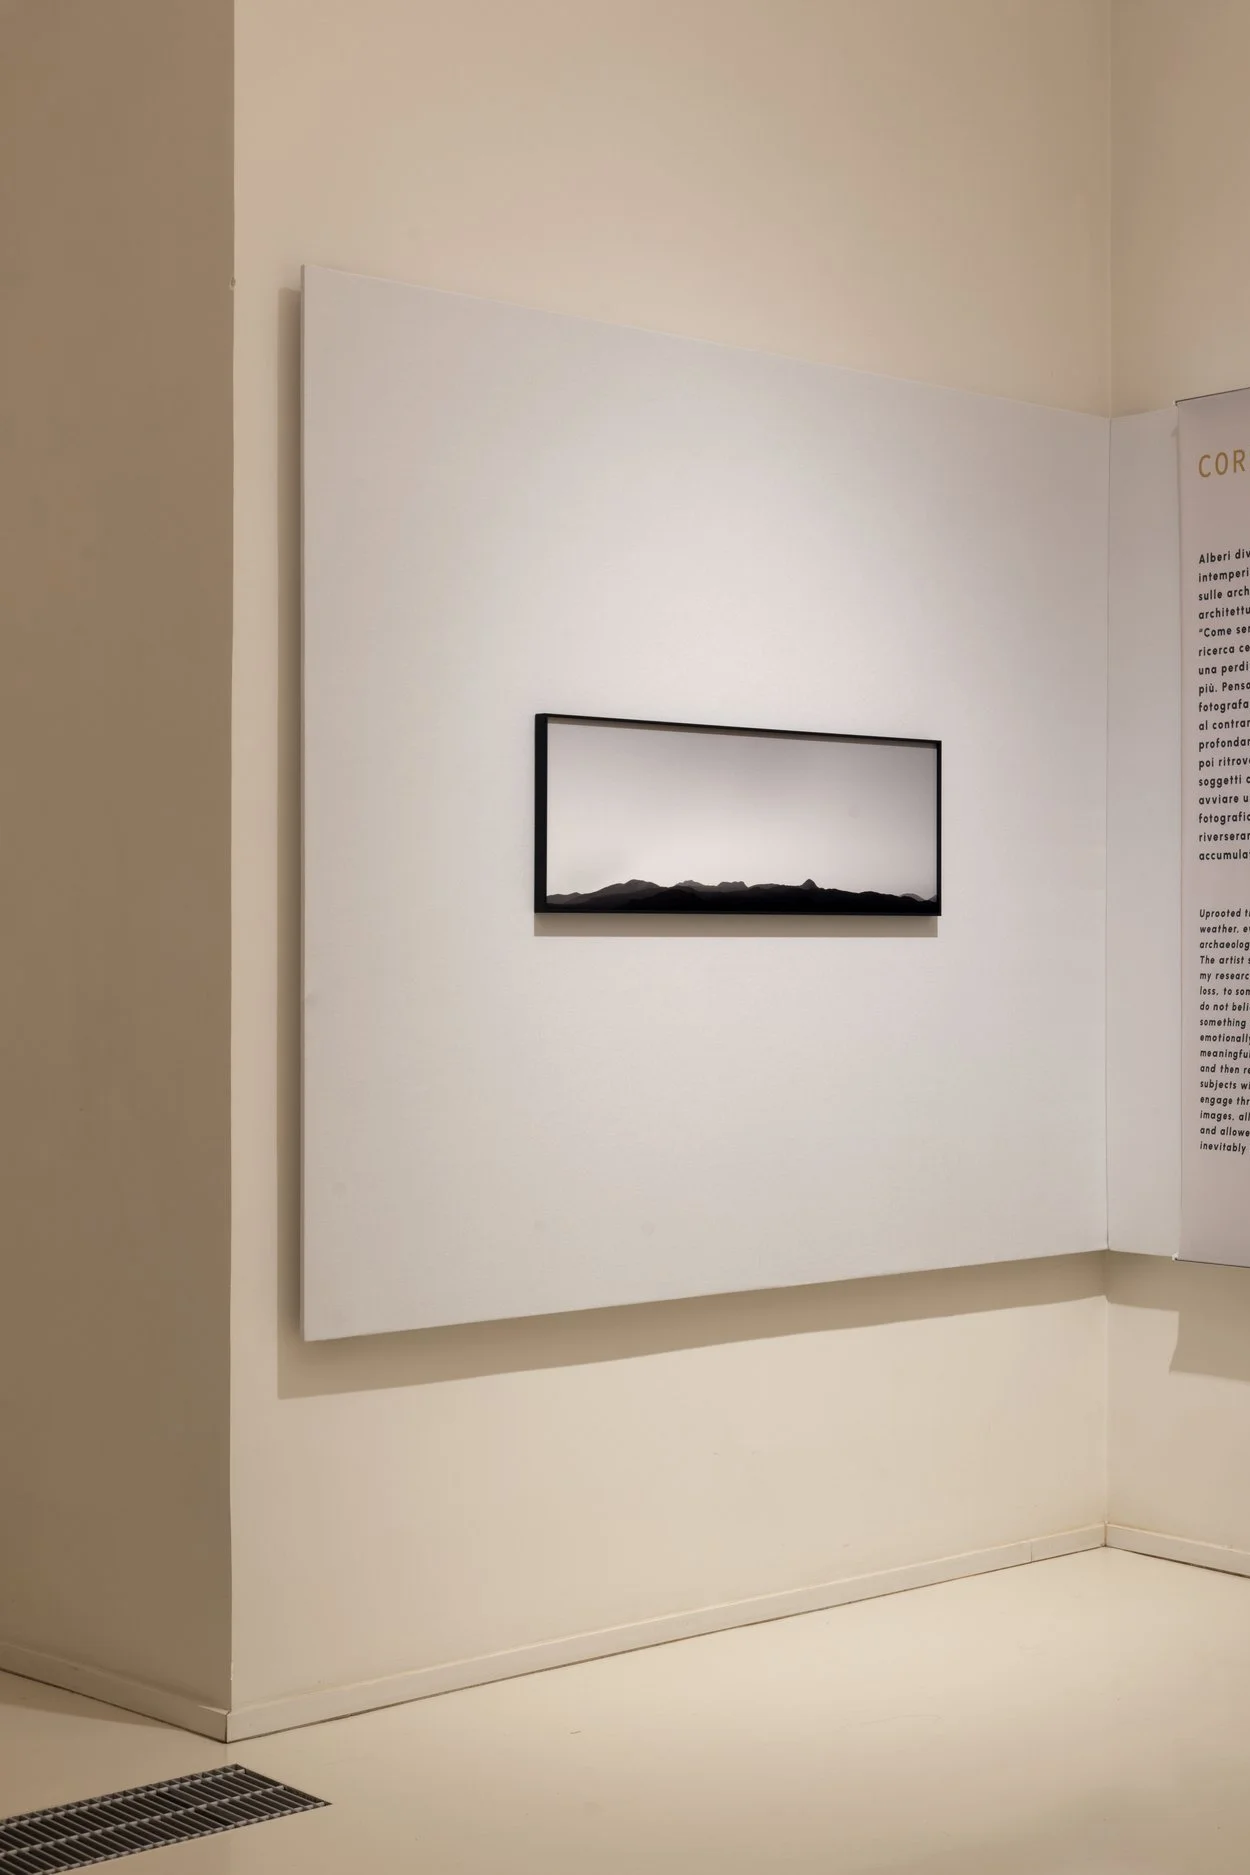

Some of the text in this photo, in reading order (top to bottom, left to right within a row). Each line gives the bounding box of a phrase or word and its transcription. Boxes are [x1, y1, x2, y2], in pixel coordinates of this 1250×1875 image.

[1198, 550, 1231, 565] Alberi
[1198, 588, 1223, 601] sulle
[1198, 646, 1235, 657] ricerca
[1198, 666, 1217, 676] una
[1198, 683, 1218, 697] più.
[1198, 719, 1208, 731] al
[1198, 757, 1214, 771] poi
[1198, 774, 1242, 789] soggetti
[1198, 794, 1239, 805] avviare
[1199, 908, 1242, 921] Uprooted
[1199, 1001, 1210, 1011] do
[1213, 1002, 1229, 1011] not
[1199, 1017, 1247, 1030] something
[1200, 1078, 1237, 1091] subjects
[1200, 1096, 1233, 1107] engage
[1199, 1125, 1217, 1135] and
[1199, 1140, 1247, 1156] inevitably
